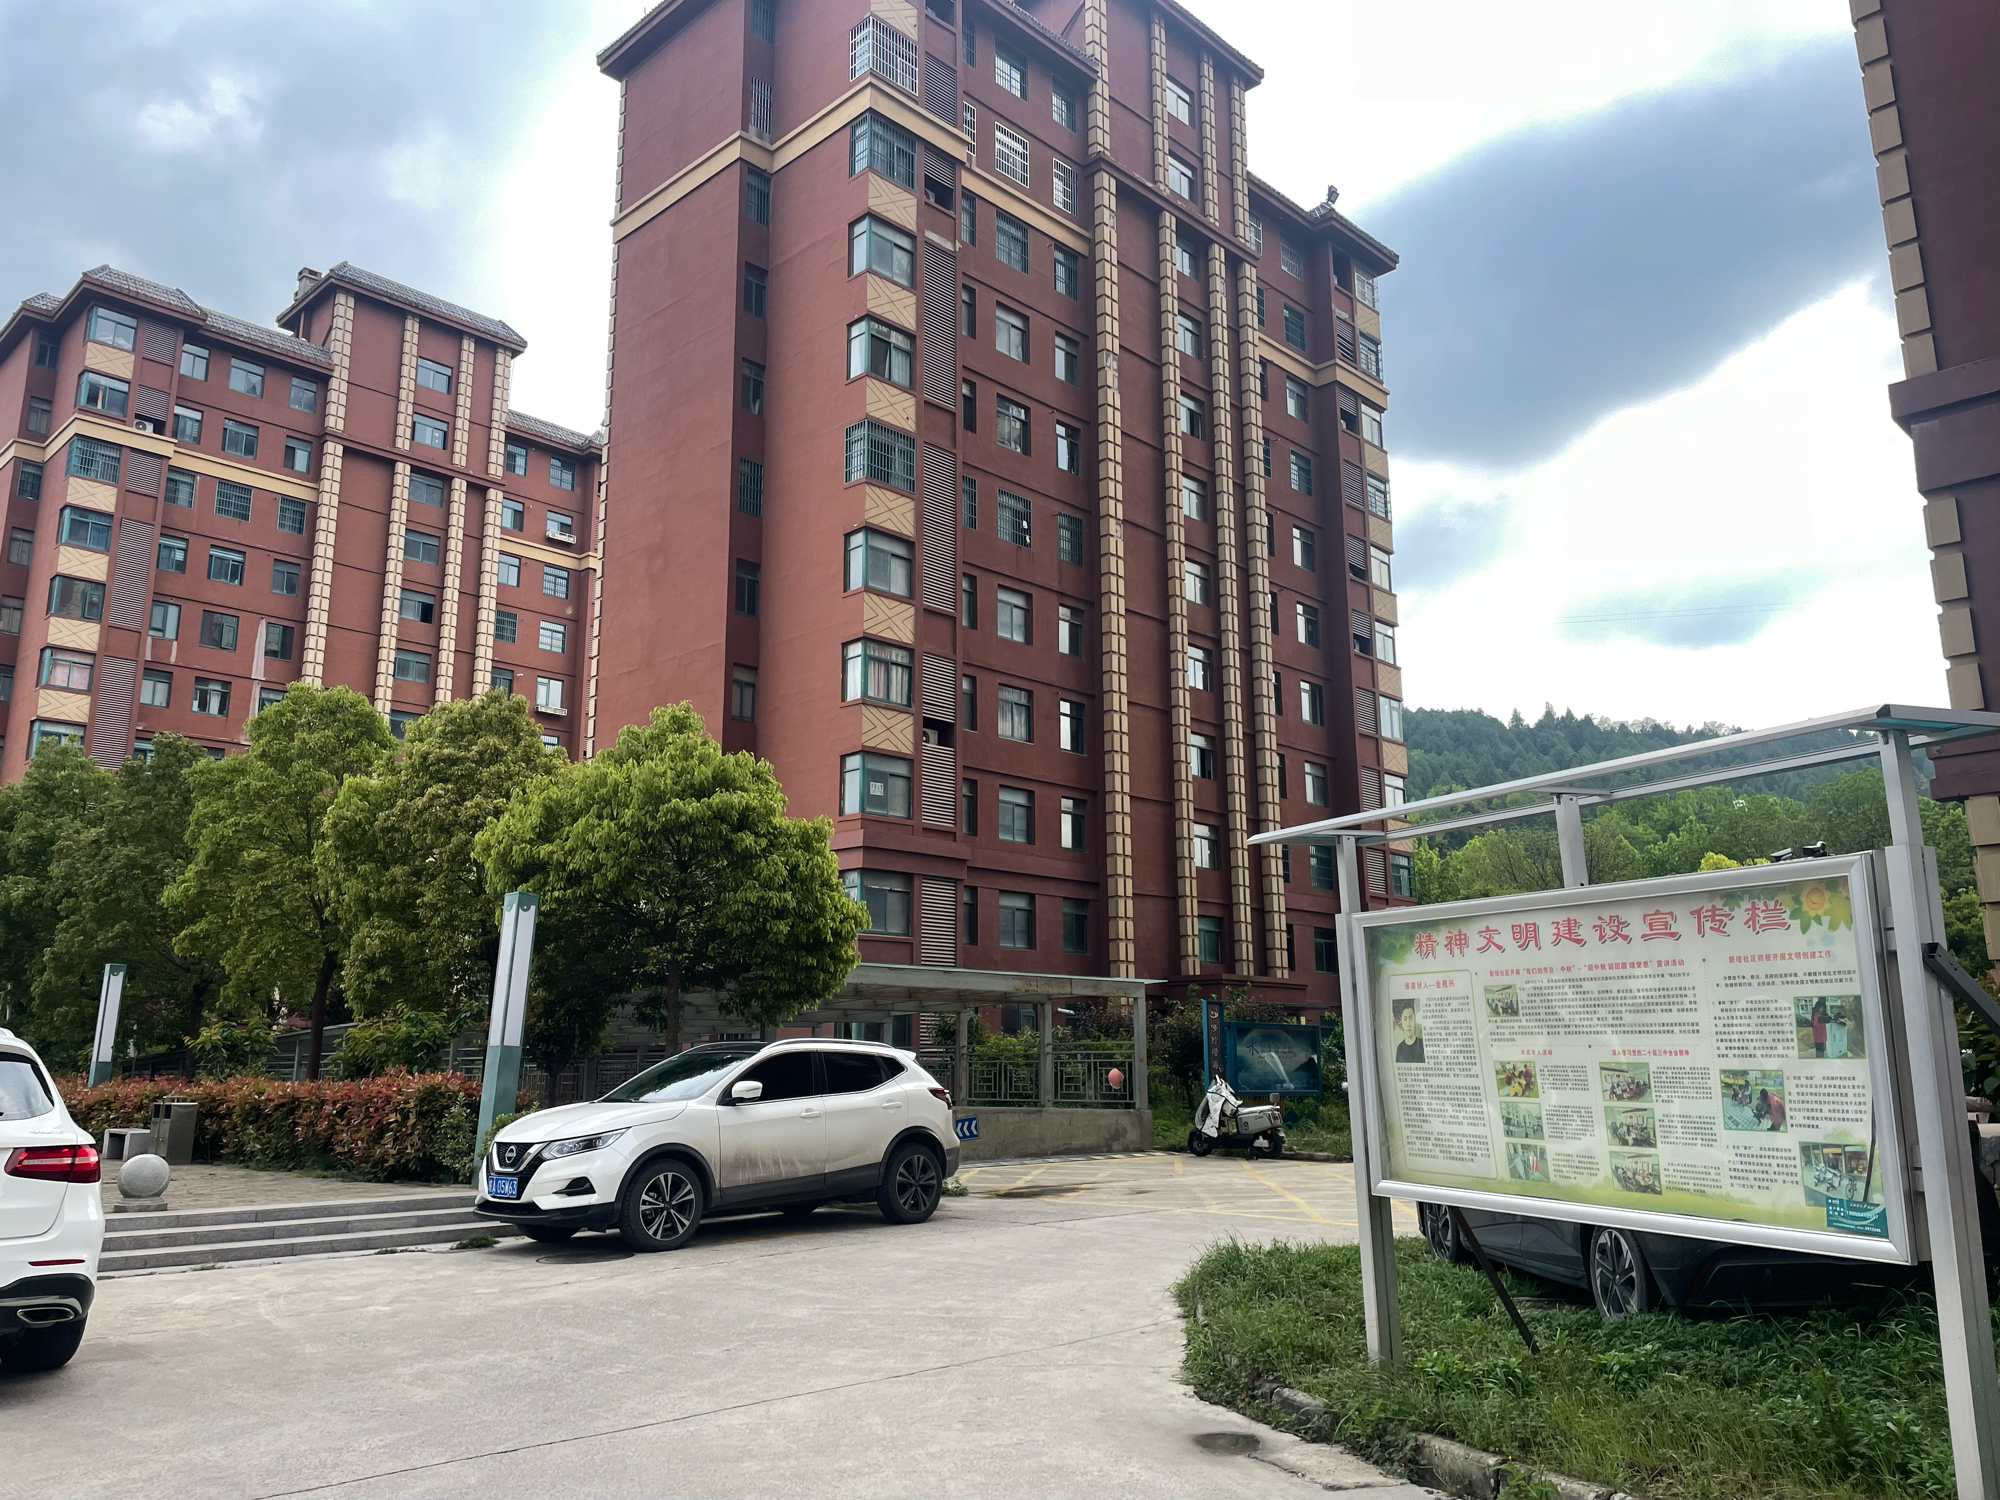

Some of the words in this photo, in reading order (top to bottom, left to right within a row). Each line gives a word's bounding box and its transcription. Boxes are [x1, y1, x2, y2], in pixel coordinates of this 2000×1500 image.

[1414, 898, 1791, 959] 精神文明建设宣传栏
